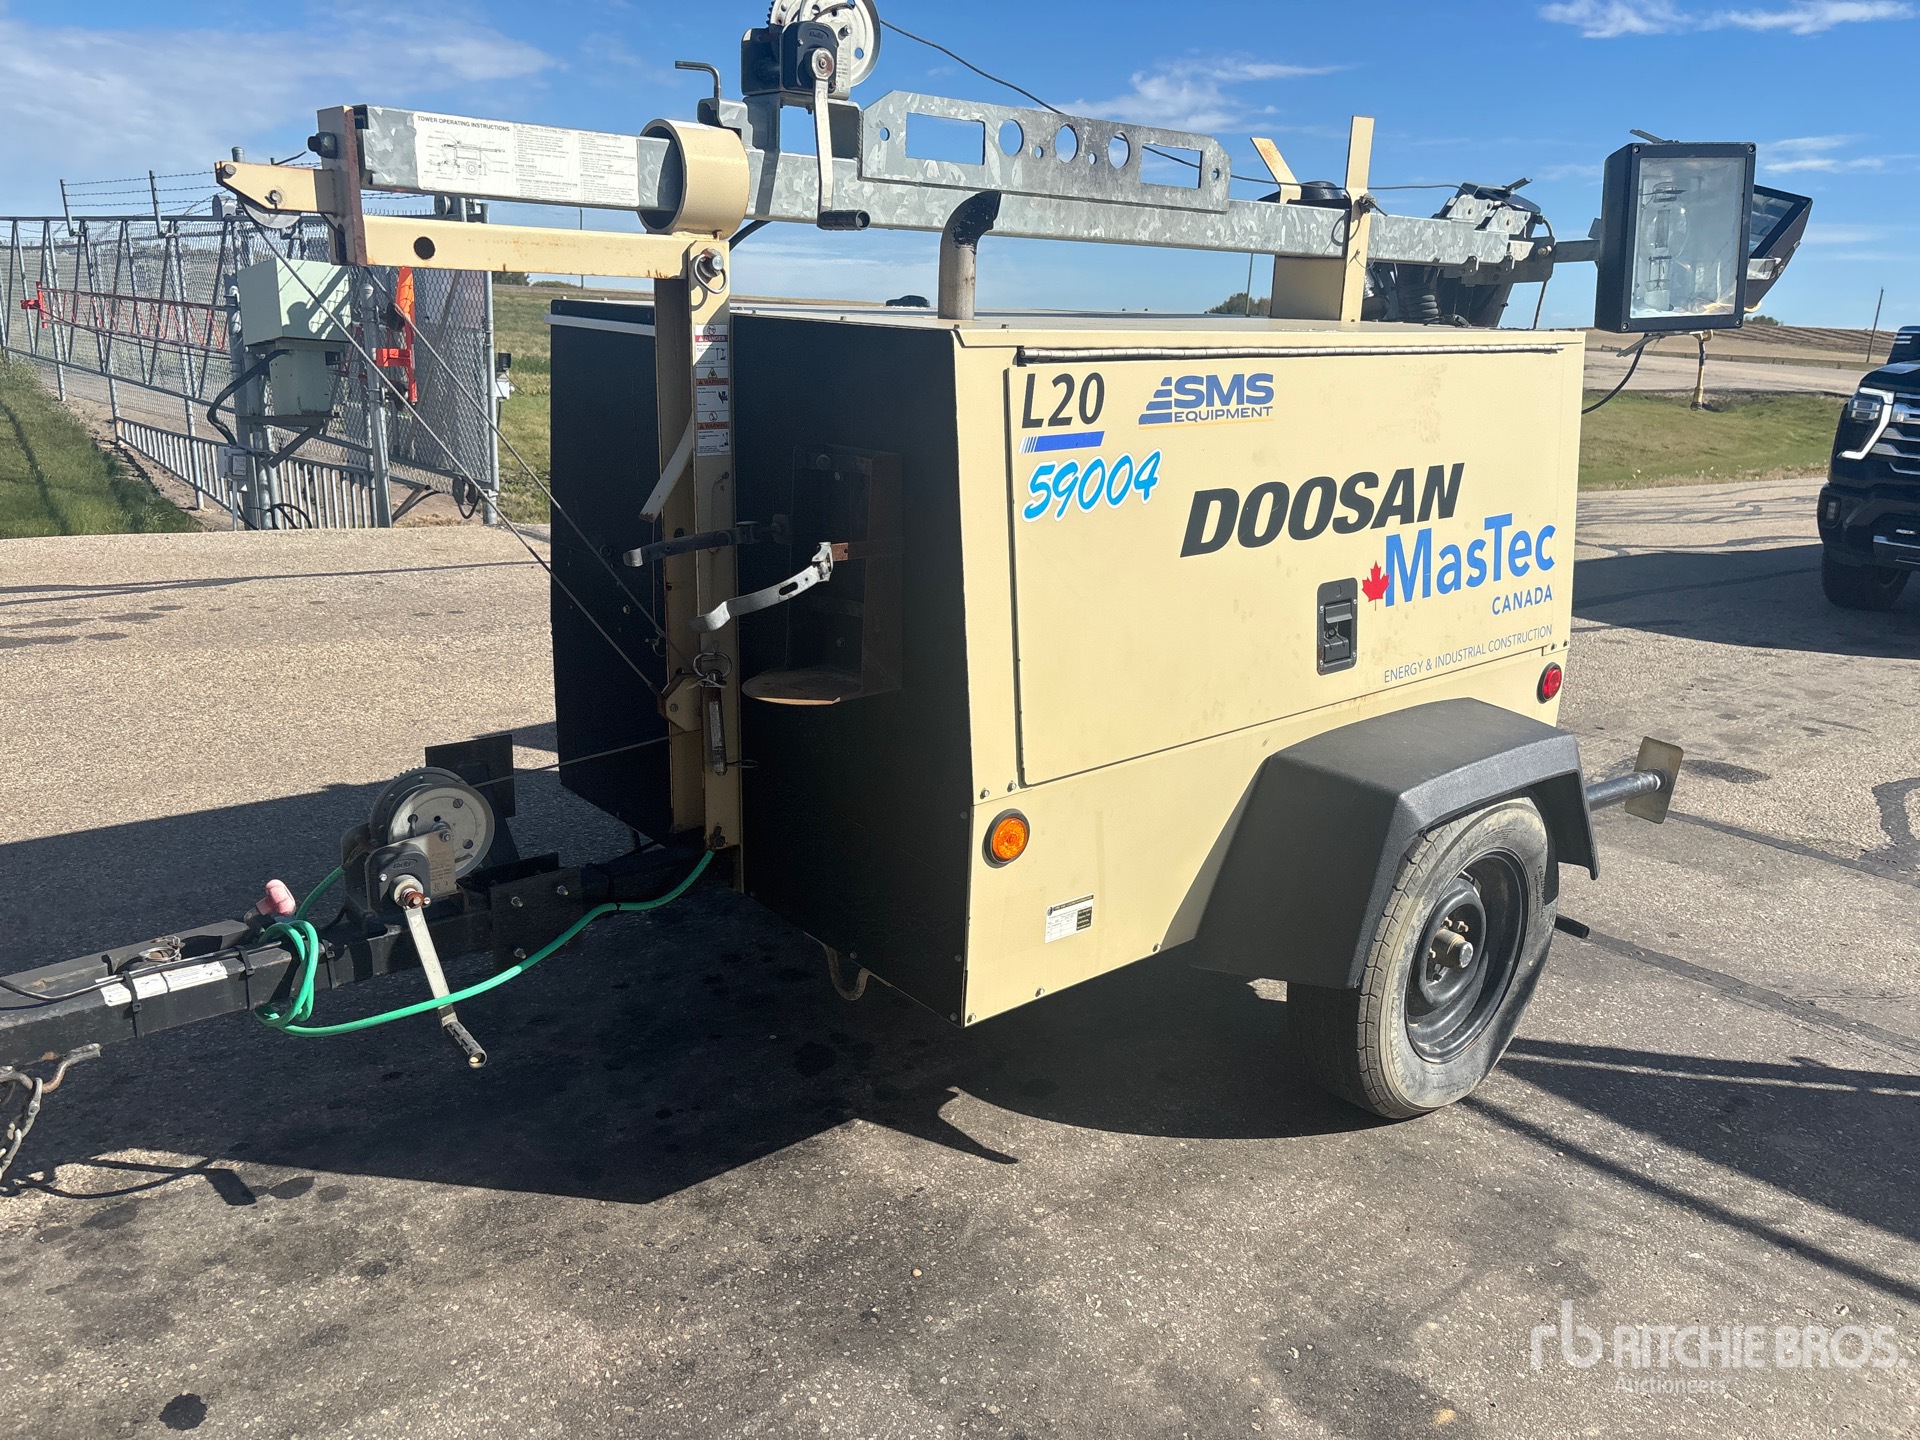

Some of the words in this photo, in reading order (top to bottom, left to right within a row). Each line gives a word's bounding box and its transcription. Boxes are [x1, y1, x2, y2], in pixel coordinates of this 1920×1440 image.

[417, 115, 438, 123] TOWER
[438, 118, 470, 127] OPERATING
[470, 121, 510, 131] INSTRUCTIONS
[1022, 372, 1105, 429] L20
[1173, 372, 1275, 409] SMS
[1174, 406, 1273, 422] EQUIPMENT
[1022, 449, 1162, 521] 59004
[1180, 462, 1465, 558] DOOSAN
[1385, 513, 1556, 607] MasTec
[1491, 584, 1553, 616] CANADA
[1384, 659, 1424, 683] ENERGY
[1425, 658, 1433, 671] &
[1435, 643, 1487, 668] INDUSTRIAL
[1488, 624, 1553, 653] CONSTRUCTION
